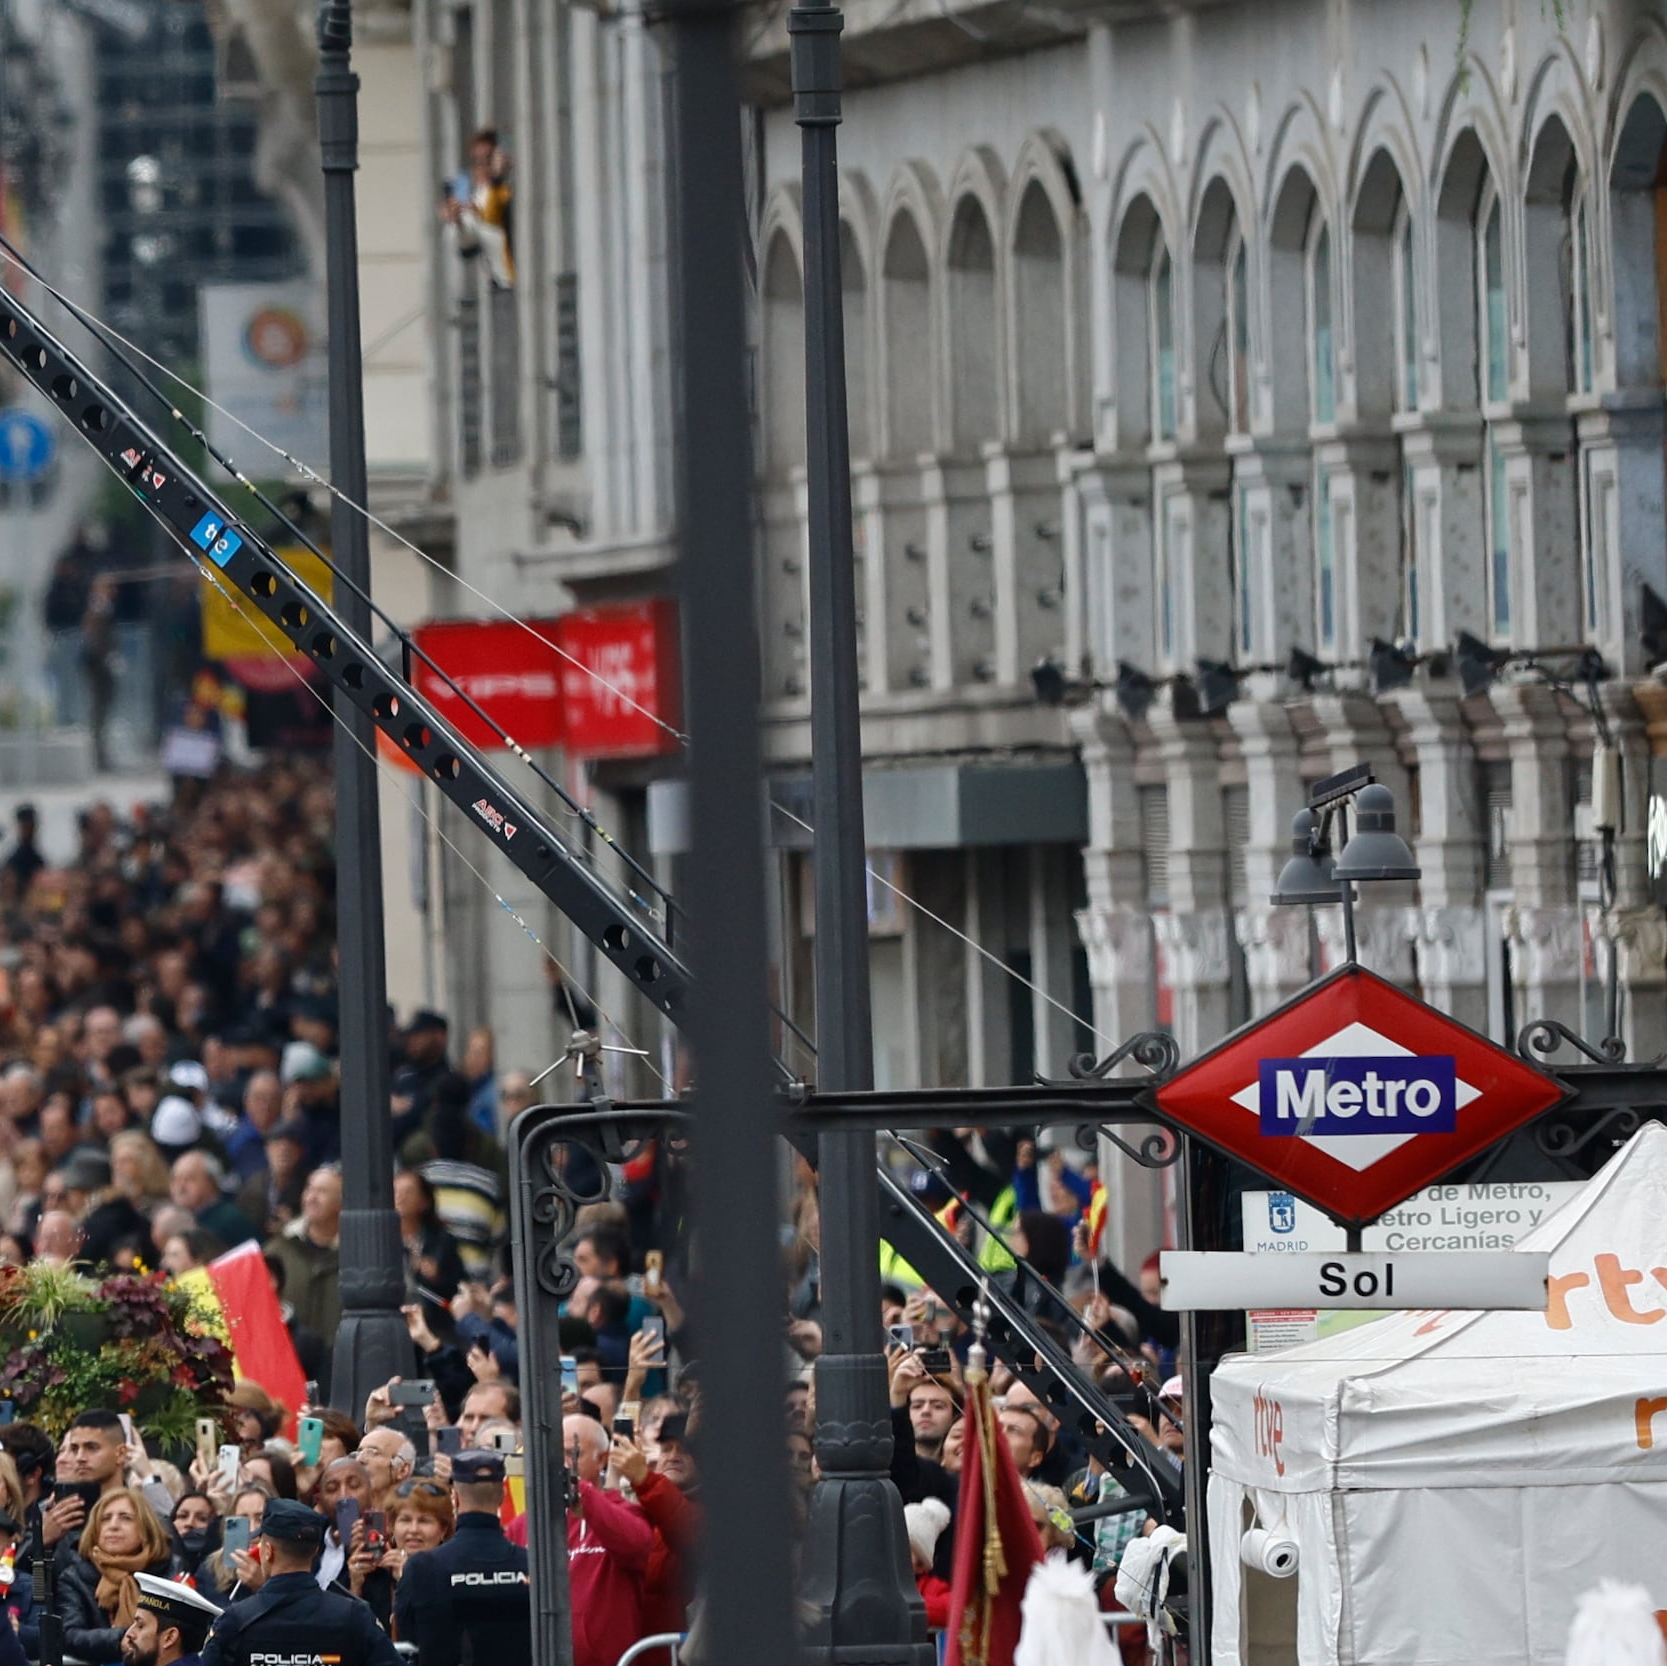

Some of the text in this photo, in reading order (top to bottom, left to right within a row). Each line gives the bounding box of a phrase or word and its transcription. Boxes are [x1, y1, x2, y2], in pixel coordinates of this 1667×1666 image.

[1275, 1069, 1442, 1119] Metro
[1441, 1207, 1520, 1228] Ligero
[1529, 1209, 1544, 1227] y
[1257, 1241, 1309, 1252] MADRID
[1386, 1231, 1515, 1251] Cercanías
[1319, 1262, 1394, 1297] Sol
[450, 1571, 528, 1586] POLICIA
[250, 1653, 323, 1665] POLICIA
